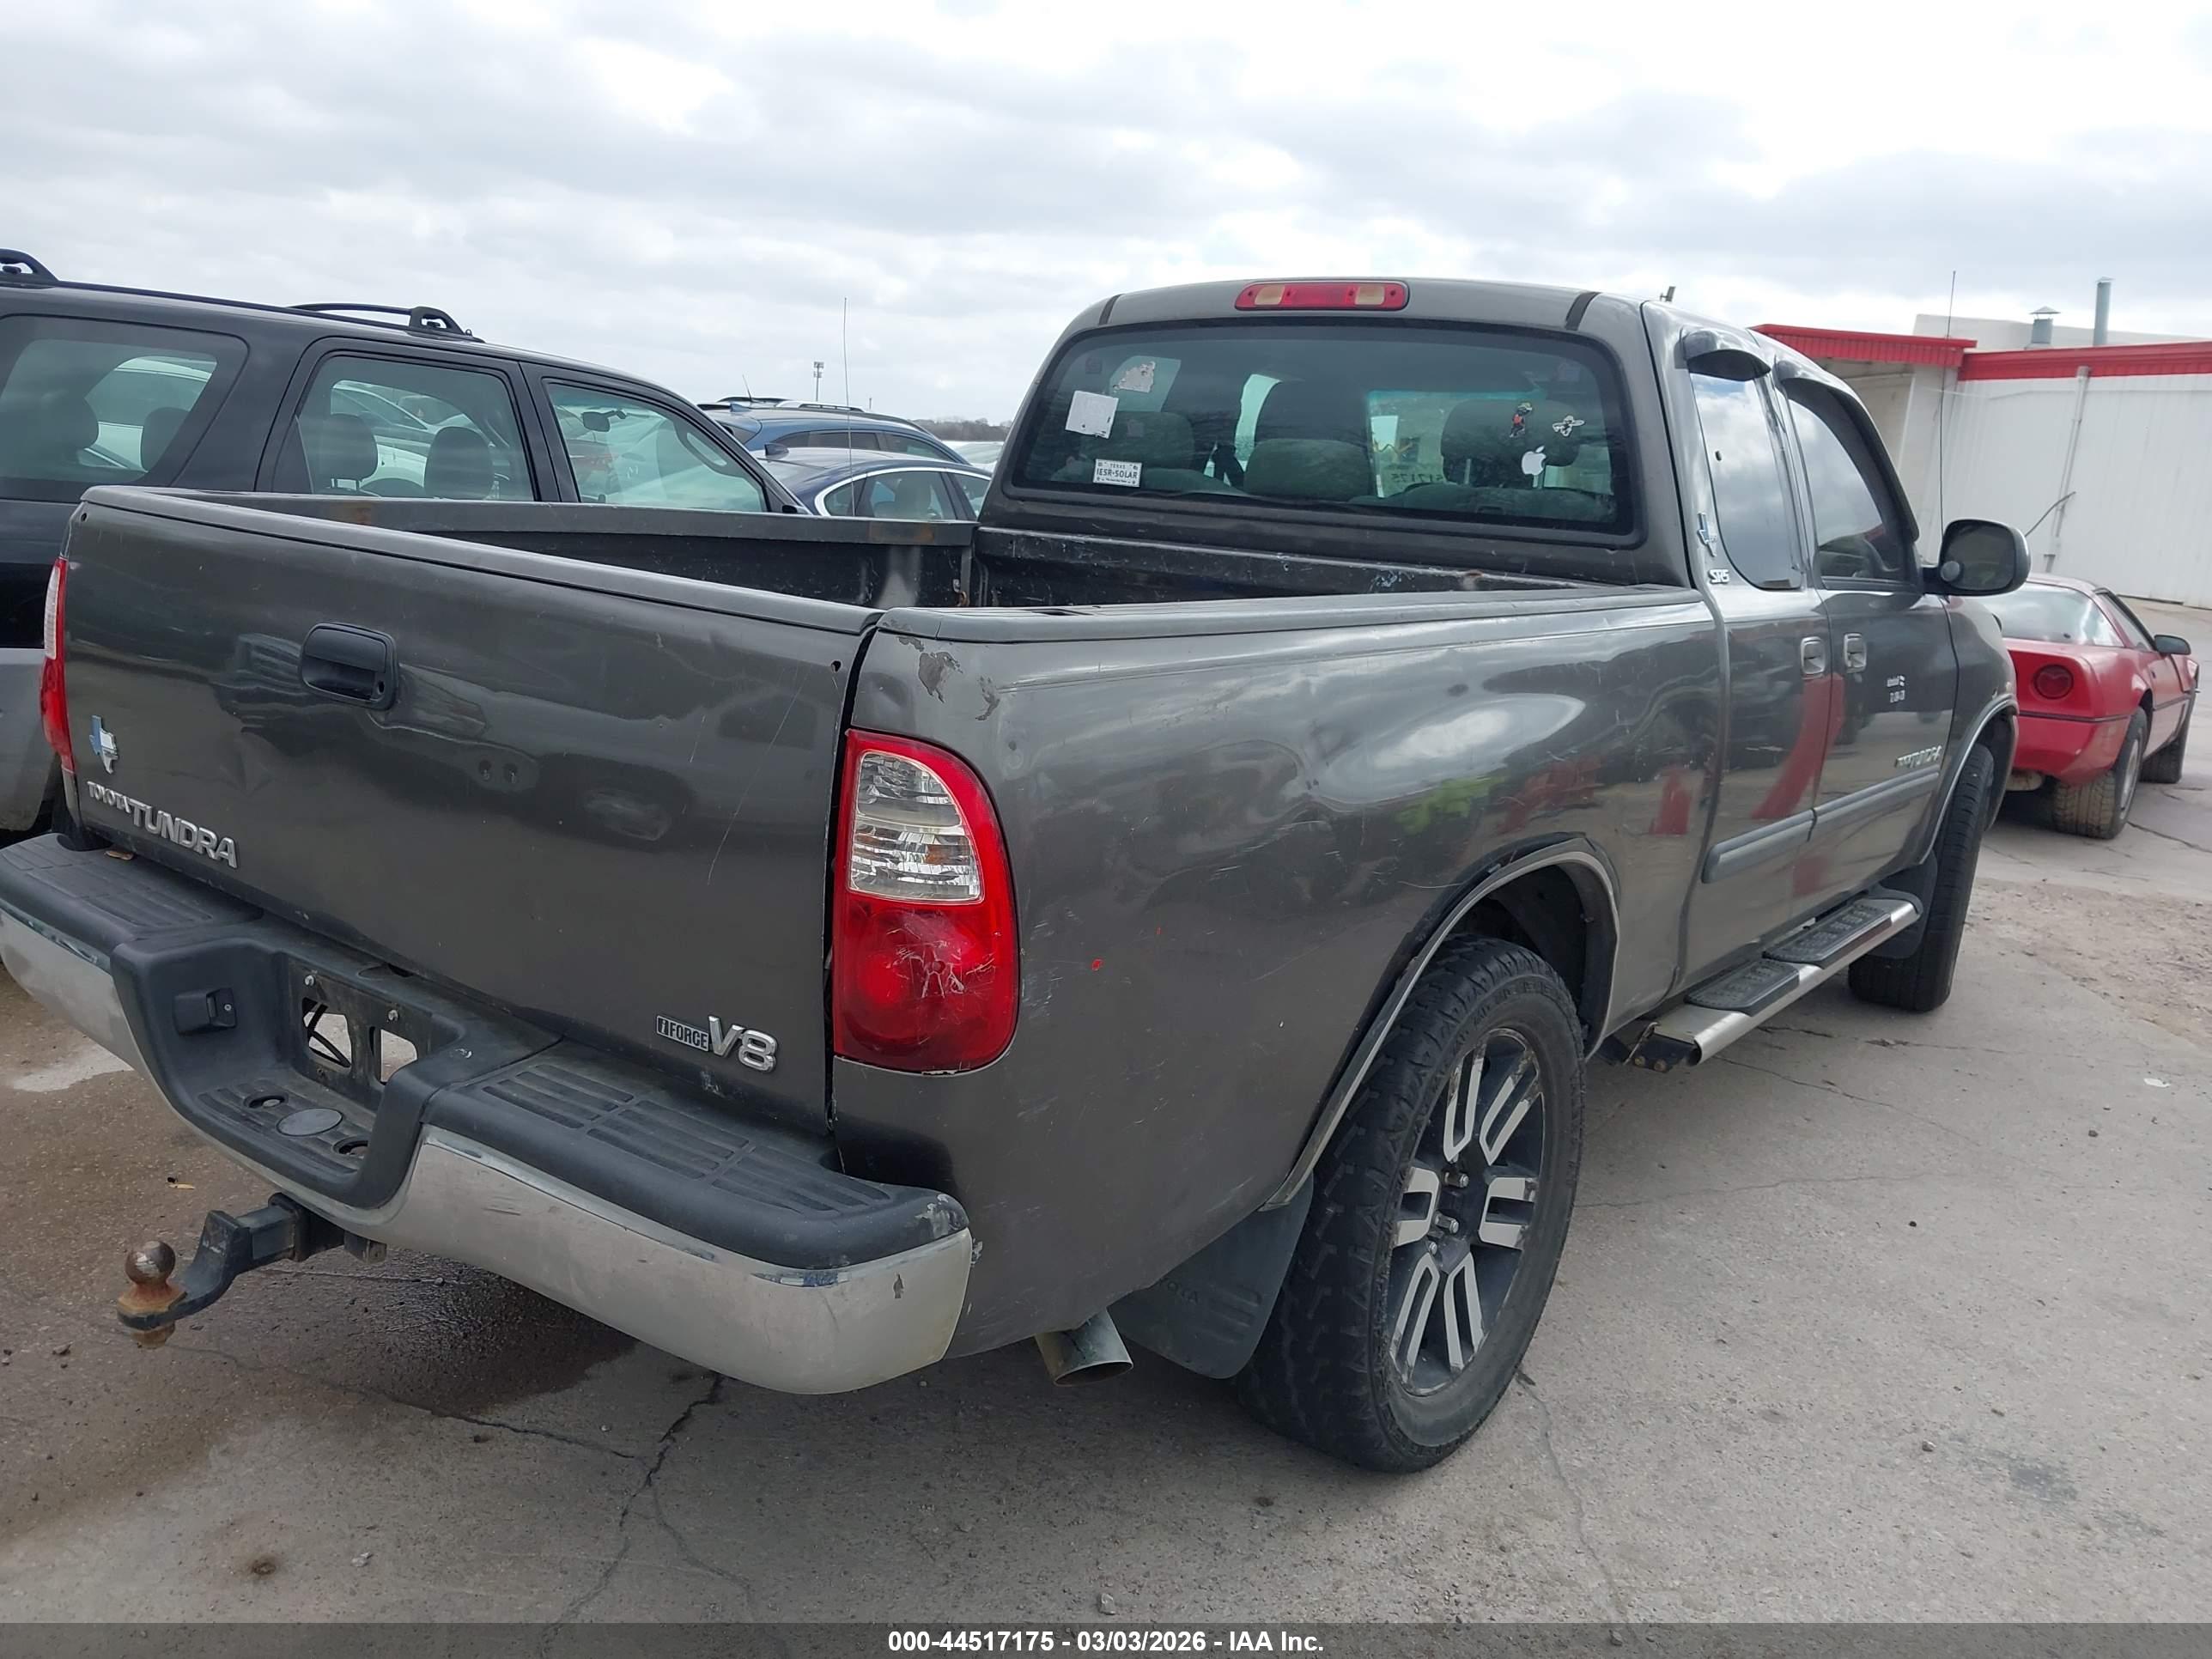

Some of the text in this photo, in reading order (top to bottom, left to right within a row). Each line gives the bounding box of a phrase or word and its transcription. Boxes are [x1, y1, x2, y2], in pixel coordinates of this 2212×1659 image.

[87, 781, 238, 869] TOYOTA TUNDRA
[708, 1015, 777, 1073] V8
